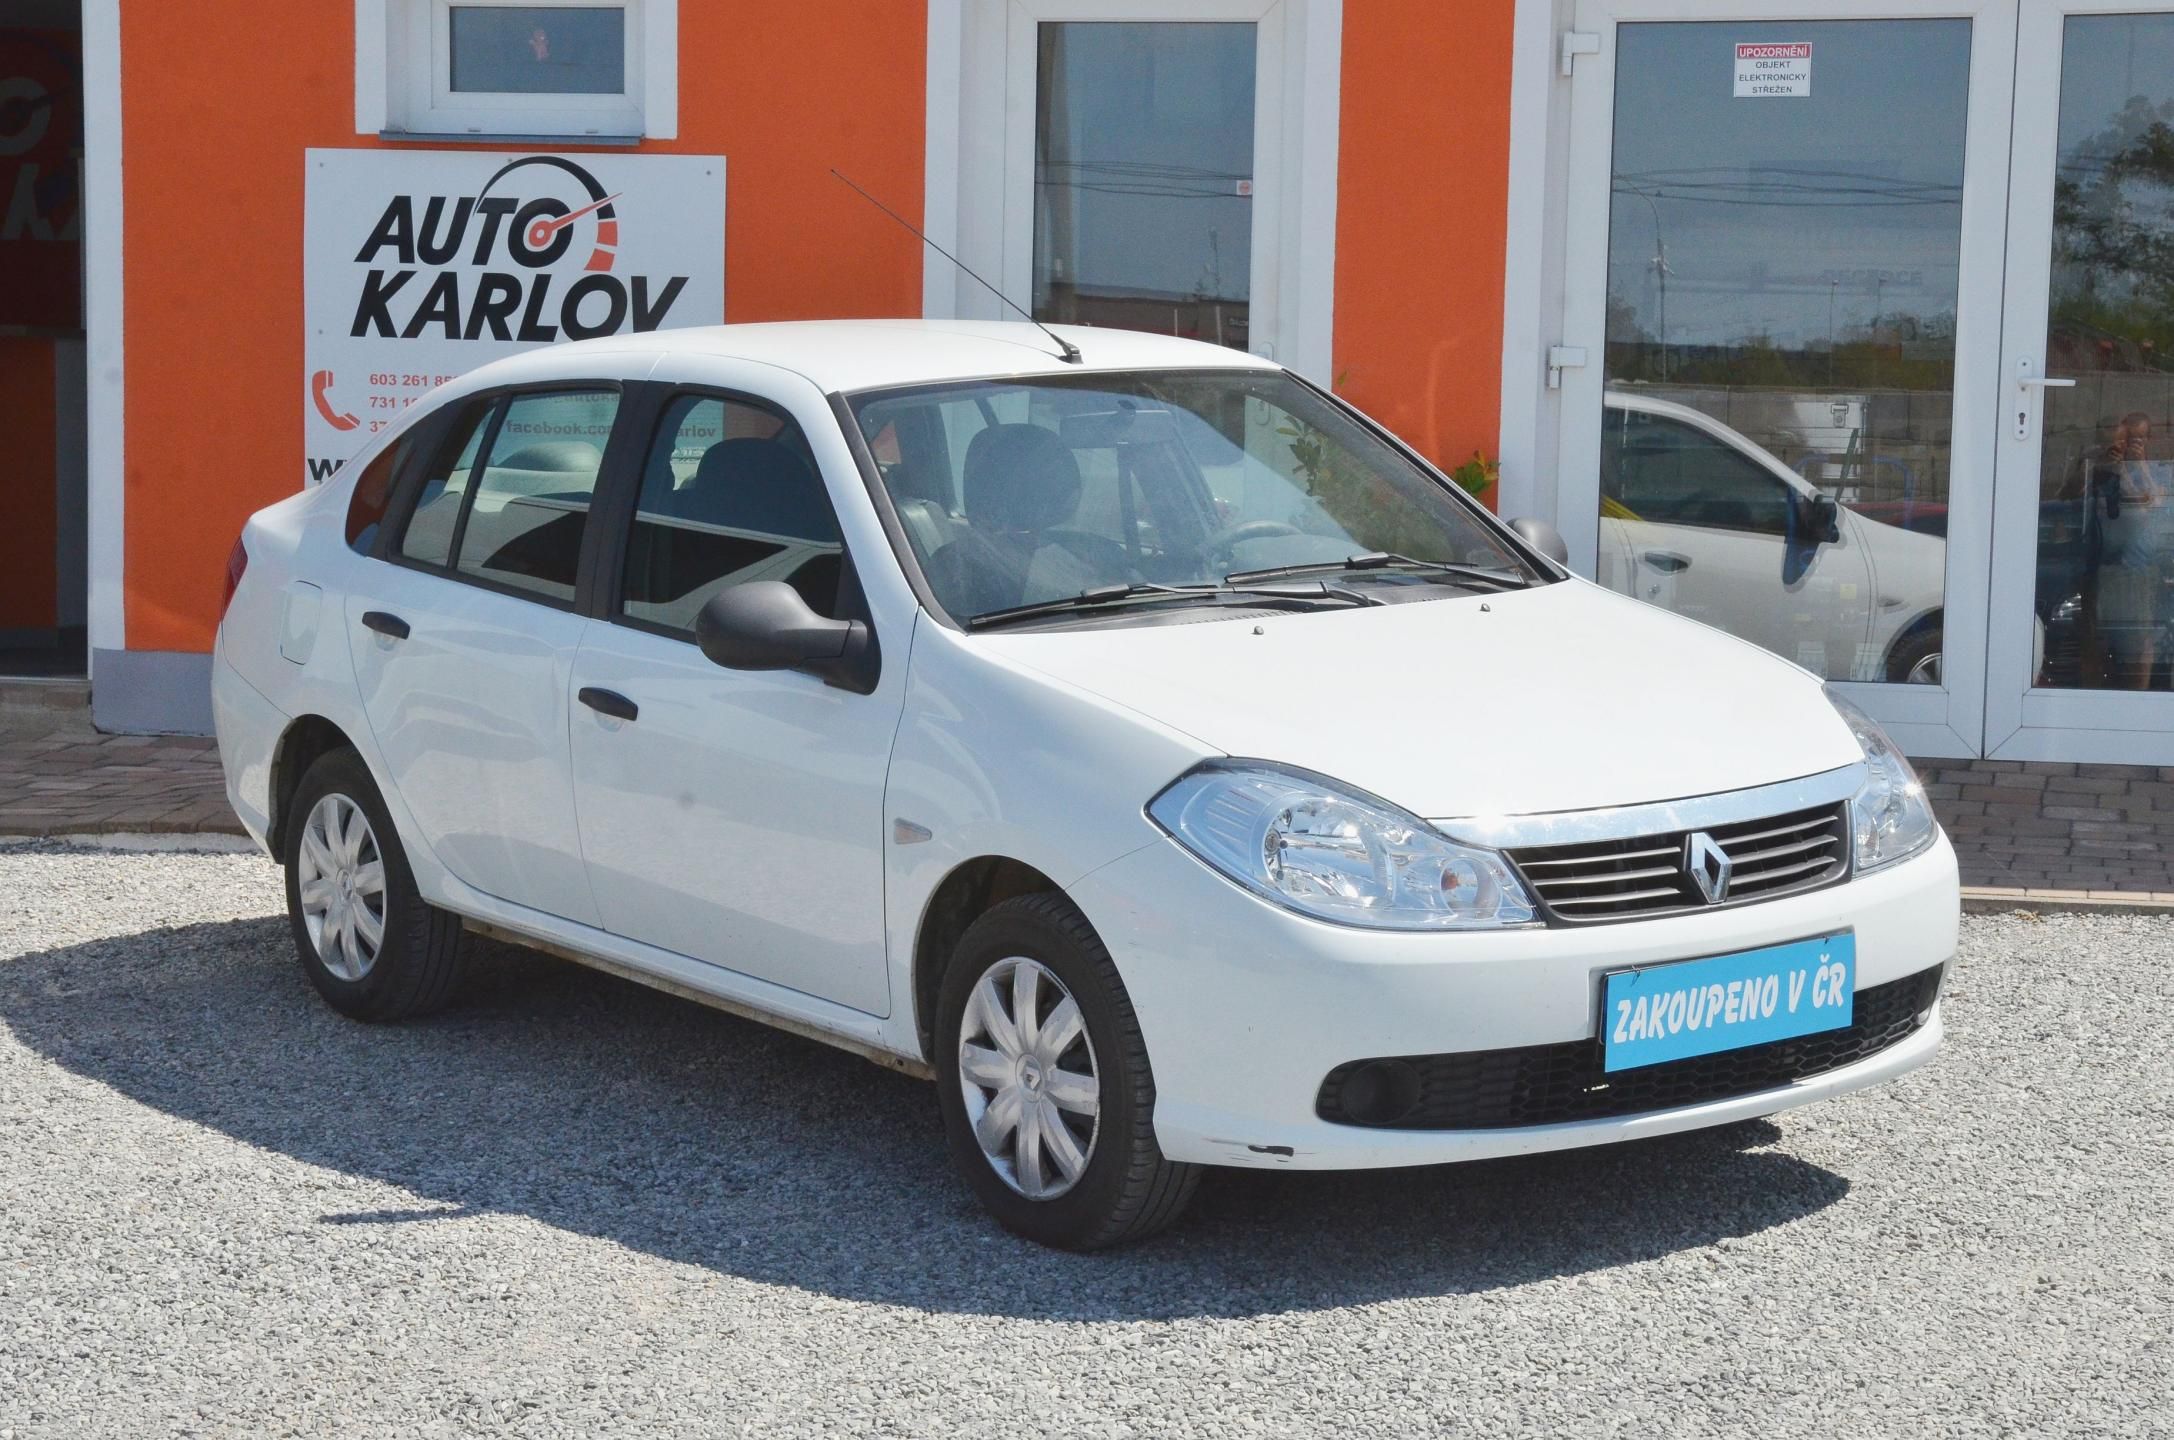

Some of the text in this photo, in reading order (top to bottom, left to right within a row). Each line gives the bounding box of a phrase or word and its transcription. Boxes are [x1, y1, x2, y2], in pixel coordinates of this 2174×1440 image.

[1740, 45, 1807, 57] UPOZORNĚNÍ
[1755, 61, 1791, 69] OBJEKT
[1739, 73, 1807, 82] ELEKTRONICKY
[354, 195, 574, 268] AUTO
[350, 270, 689, 342] KARLOV
[370, 374, 459, 387] 603 261 85
[369, 396, 418, 408] 731 1
[1613, 953, 1847, 1043] ZAKOUPENO V ČR
